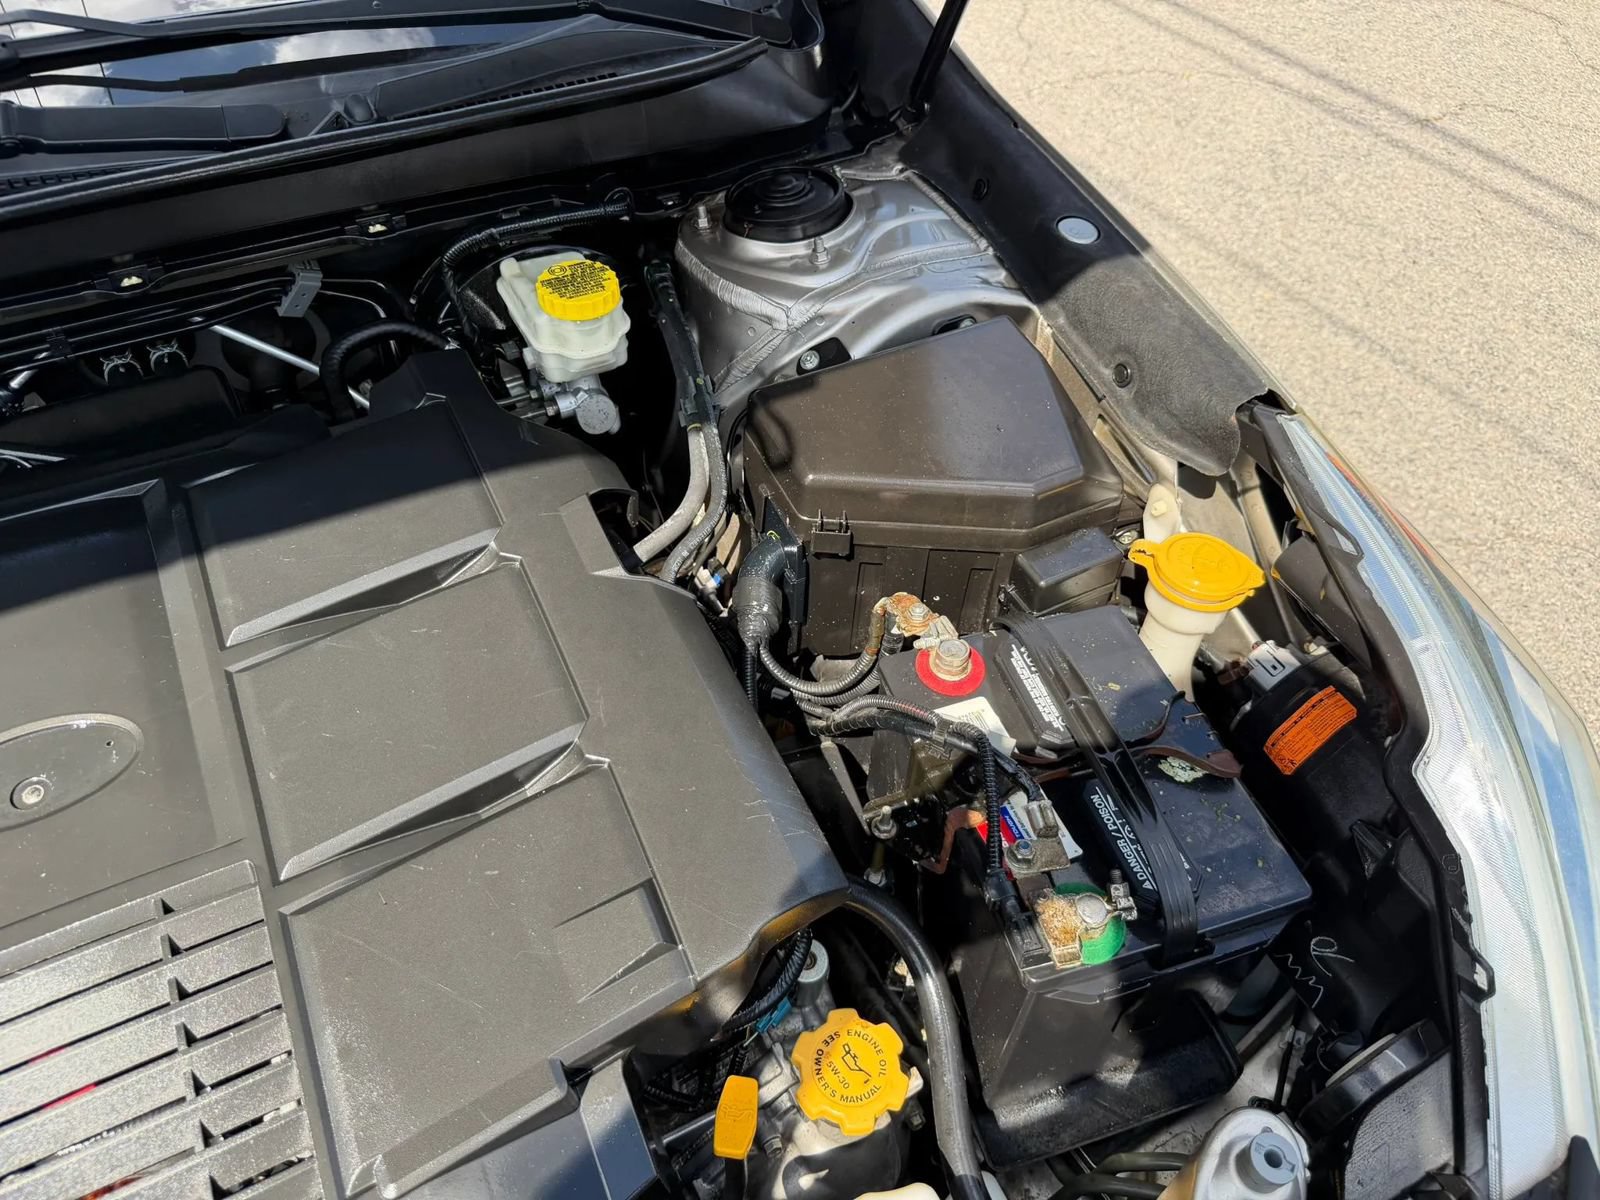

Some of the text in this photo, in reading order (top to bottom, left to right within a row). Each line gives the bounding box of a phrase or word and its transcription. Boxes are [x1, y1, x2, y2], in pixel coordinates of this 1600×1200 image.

[1090, 794, 1118, 831] POISON
[1117, 838, 1147, 881] DANGER
[814, 1030, 882, 1104] SEE OWNER'S MANUAL
[846, 1029, 887, 1078] ENGINE OIL
[826, 1061, 850, 1090] 5W-30
